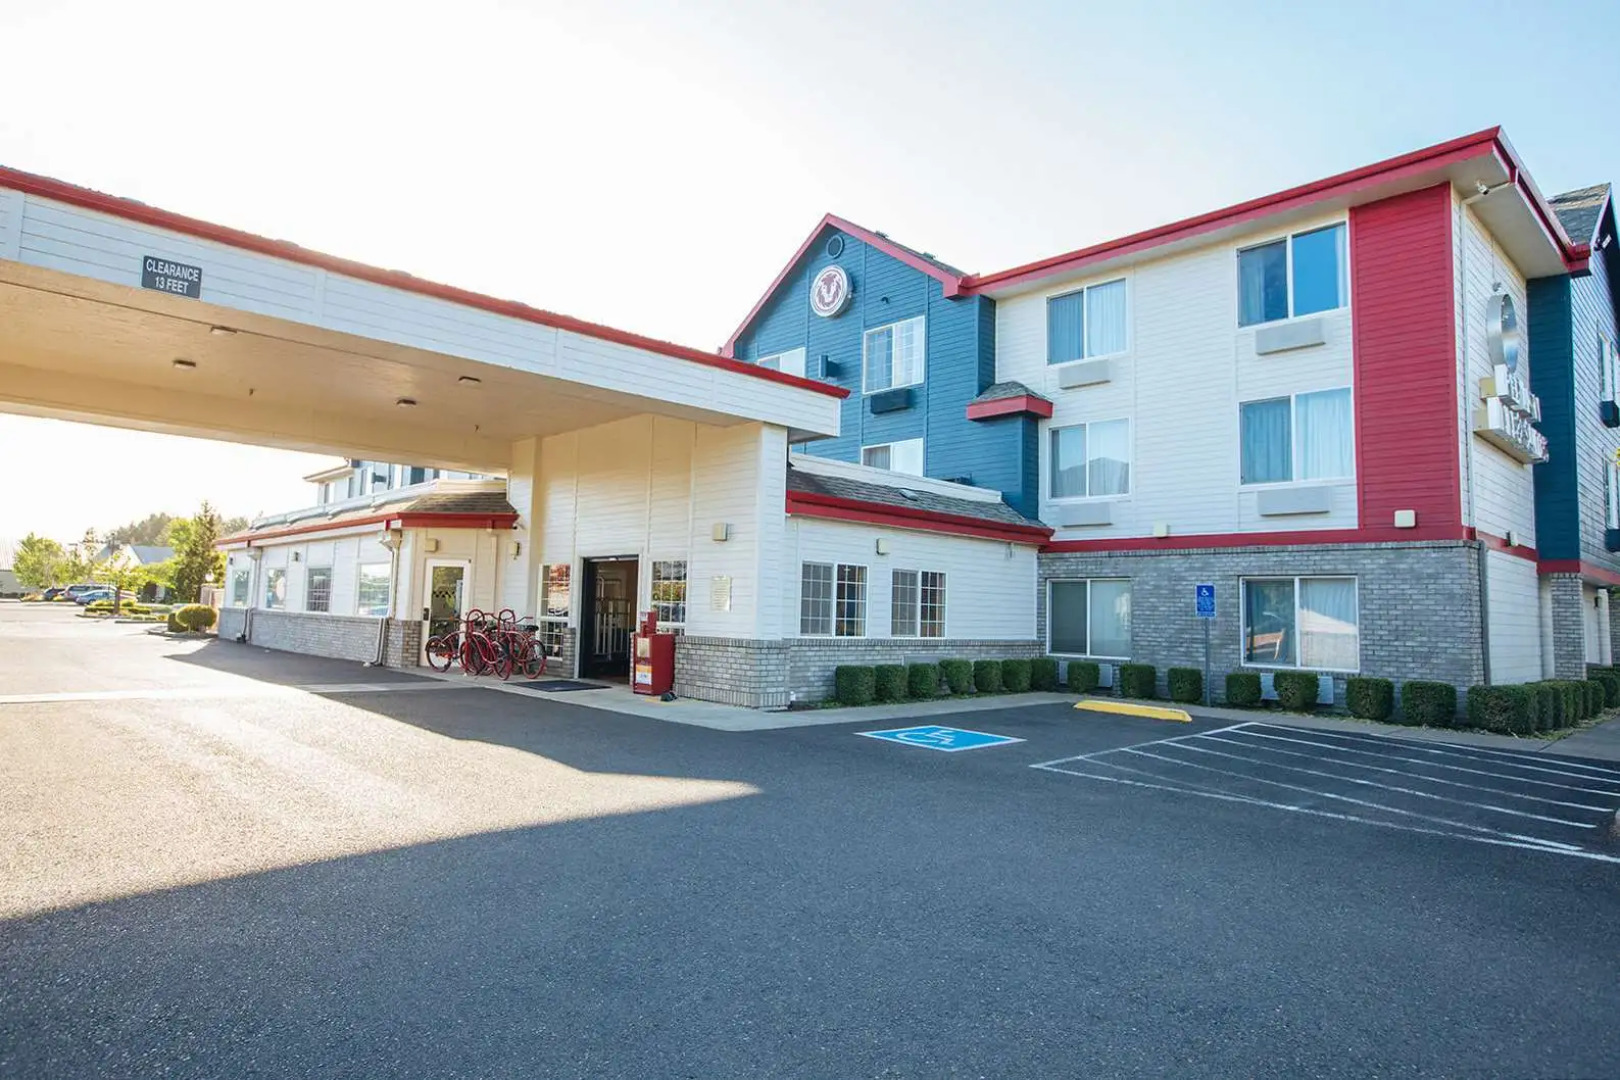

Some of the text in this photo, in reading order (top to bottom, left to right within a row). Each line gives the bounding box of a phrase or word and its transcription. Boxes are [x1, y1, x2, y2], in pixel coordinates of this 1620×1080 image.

[146, 259, 199, 282] CLEARANCE
[155, 276, 189, 294] 13 FEET
